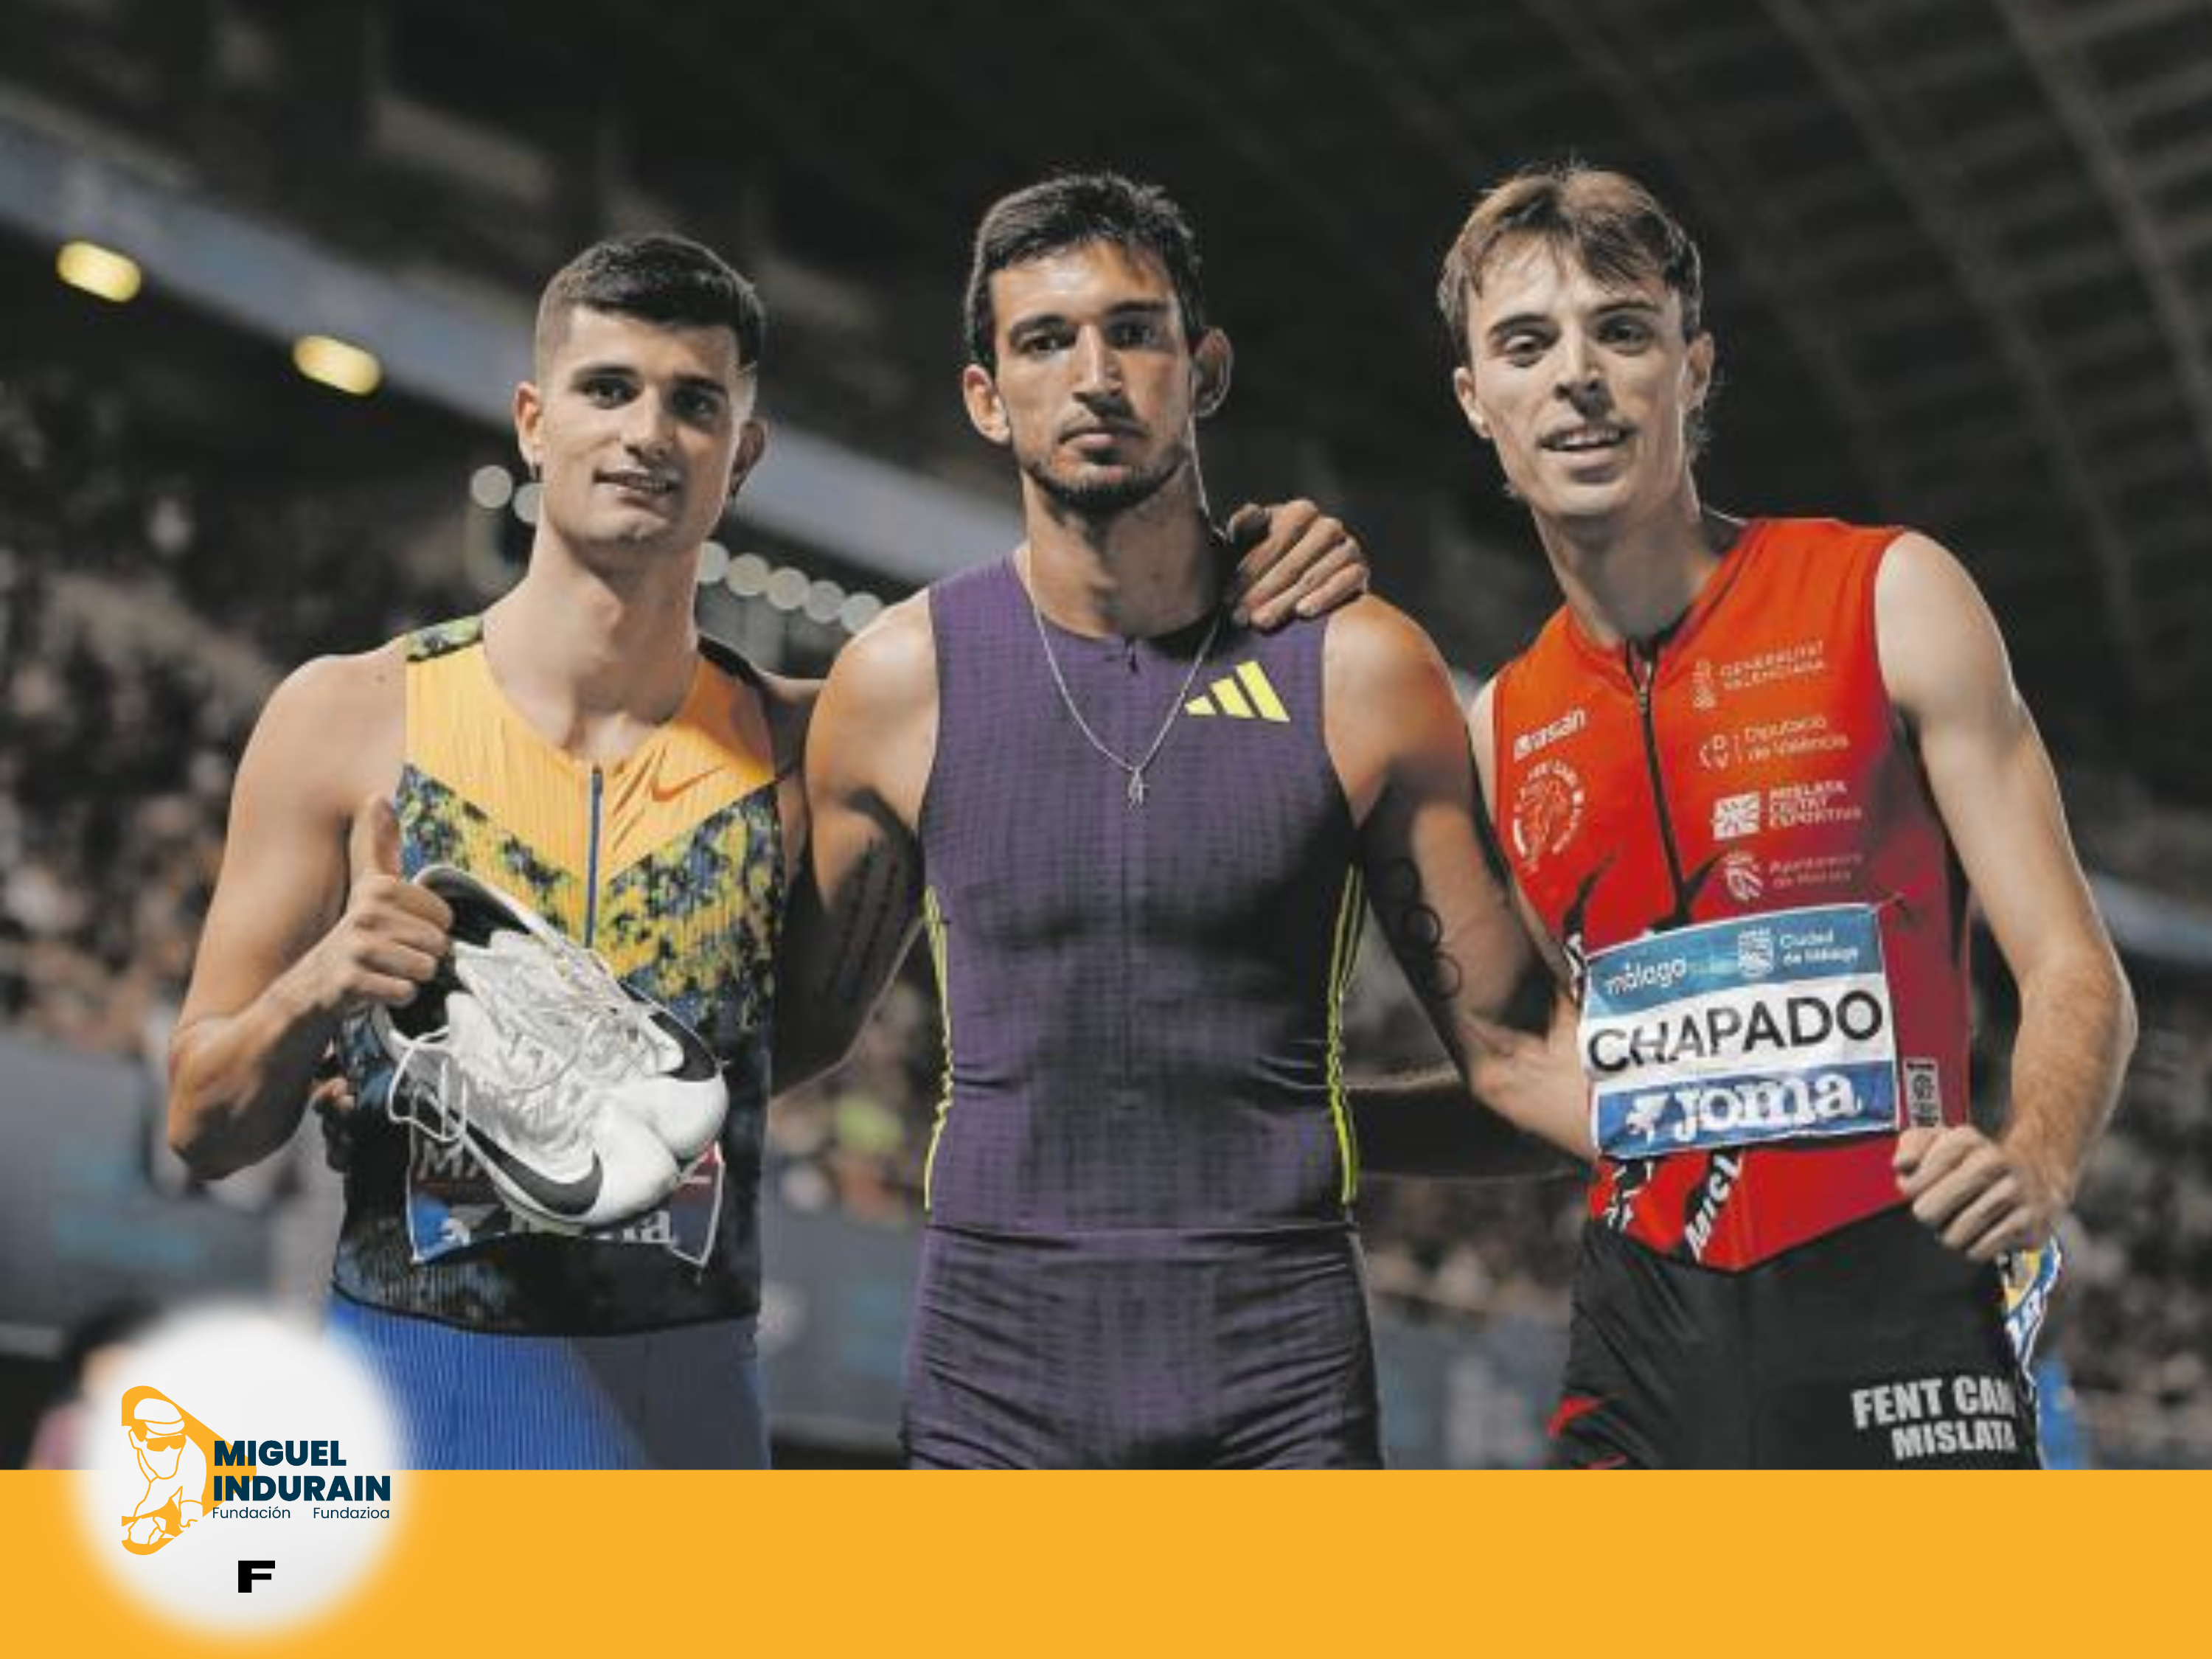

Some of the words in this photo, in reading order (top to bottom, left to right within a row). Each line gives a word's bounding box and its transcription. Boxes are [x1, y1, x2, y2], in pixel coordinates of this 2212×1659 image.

[1587, 990, 1883, 1073] CHAPADO
[1850, 1377, 1943, 1430] FENT
[1891, 1419, 2018, 1461] MISLATA
